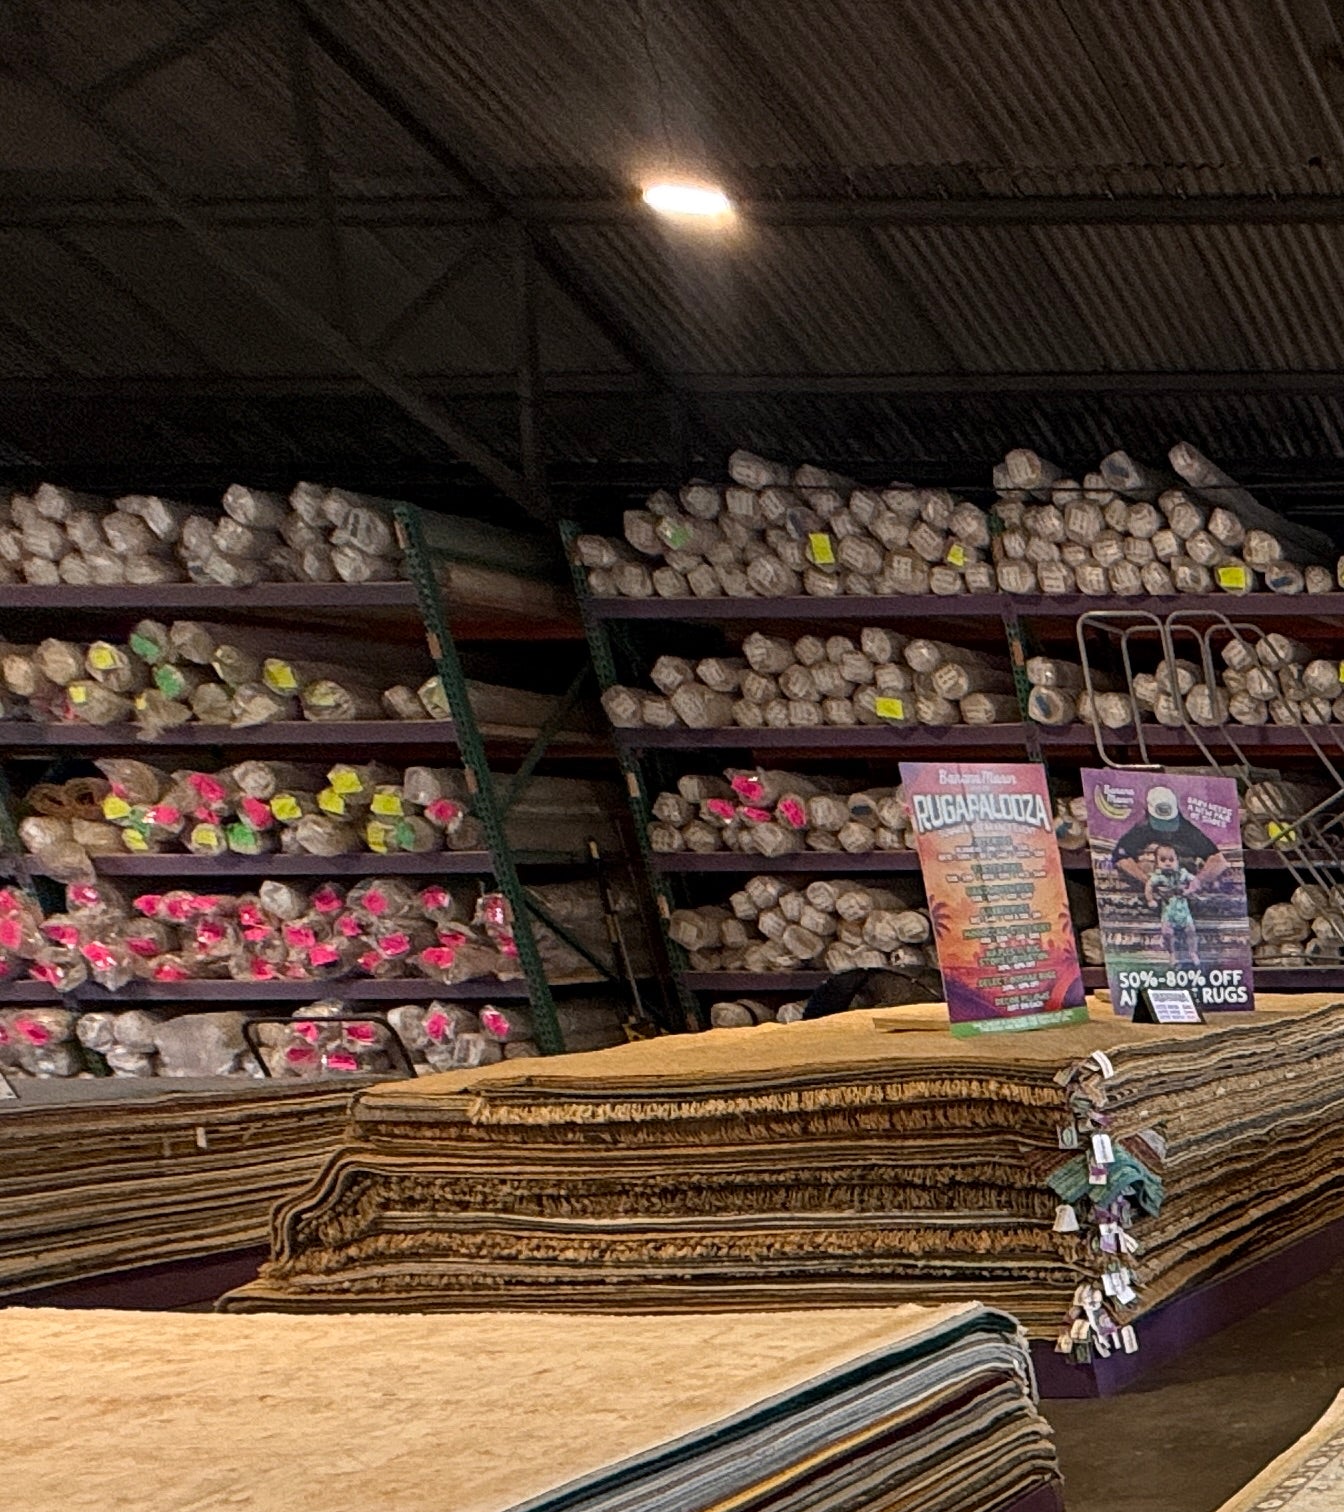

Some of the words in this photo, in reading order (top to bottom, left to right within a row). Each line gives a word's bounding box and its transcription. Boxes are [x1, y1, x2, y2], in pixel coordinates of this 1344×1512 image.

[912, 793, 1051, 833] RUGAPALOOZA
[1119, 970, 1206, 988] 50%-80%
[1209, 970, 1243, 986] OFF
[1202, 986, 1248, 1003] RUGS
